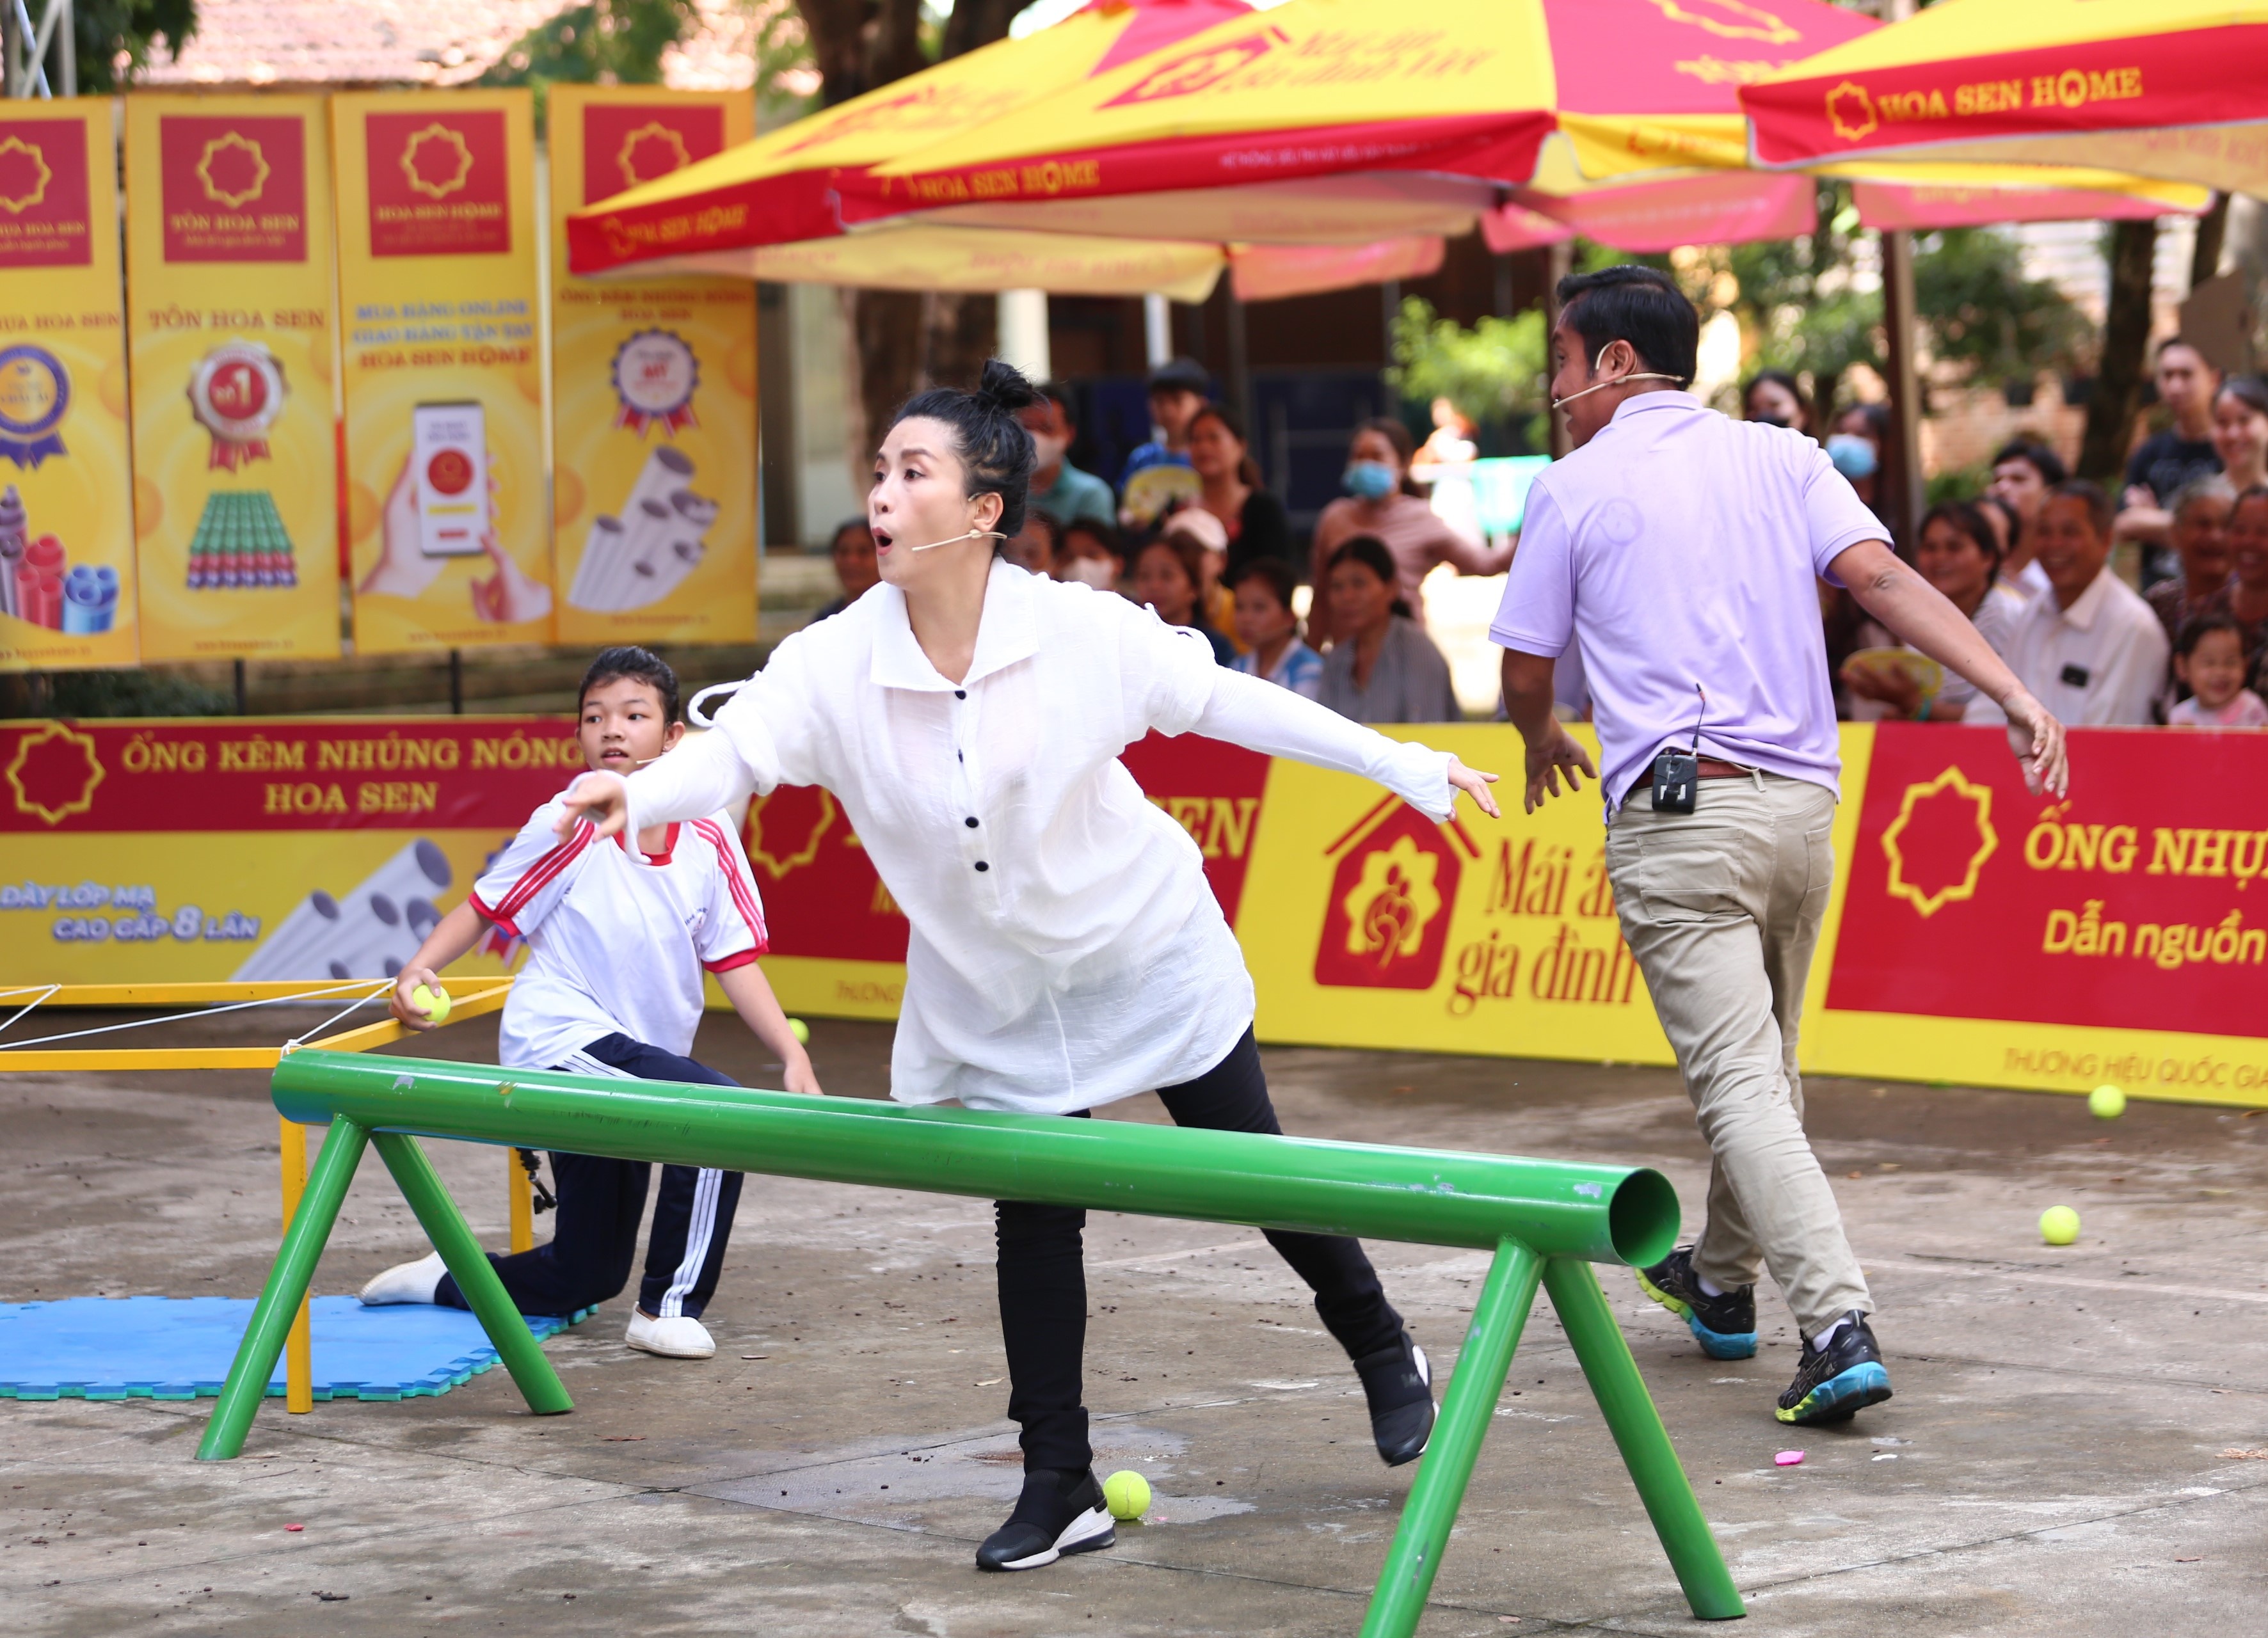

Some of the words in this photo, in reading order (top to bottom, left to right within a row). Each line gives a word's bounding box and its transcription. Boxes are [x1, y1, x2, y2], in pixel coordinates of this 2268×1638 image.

[1879, 91, 1950, 122] HOA
[1954, 78, 2023, 116] SEN
[2030, 66, 2144, 109] HOME
[919, 175, 970, 200] HOA
[972, 168, 1021, 195] SEN
[1021, 159, 1101, 193] HOME
[214, 214, 257, 232] HOA
[260, 213, 299, 232] SEN
[377, 205, 413, 221] HOA
[416, 203, 447, 219] SEN
[660, 216, 691, 241] SEN
[696, 204, 749, 237] HOME
[148, 302, 202, 330] TÔN
[210, 308, 266, 329] HOA
[273, 308, 325, 328] SEN
[360, 350, 408, 369] HOA
[411, 349, 454, 367] SEN
[460, 344, 532, 368] HOME
[264, 782, 348, 815] HOA
[358, 780, 438, 814] SEN
[1146, 794, 1261, 859] EN
[2024, 799, 2139, 873] ỐNG
[1485, 837, 1572, 916] Mái
[52, 917, 111, 942] CAO
[171, 903, 204, 943] 8
[1446, 927, 1519, 1018] gia
[1531, 921, 1638, 1005] đình
